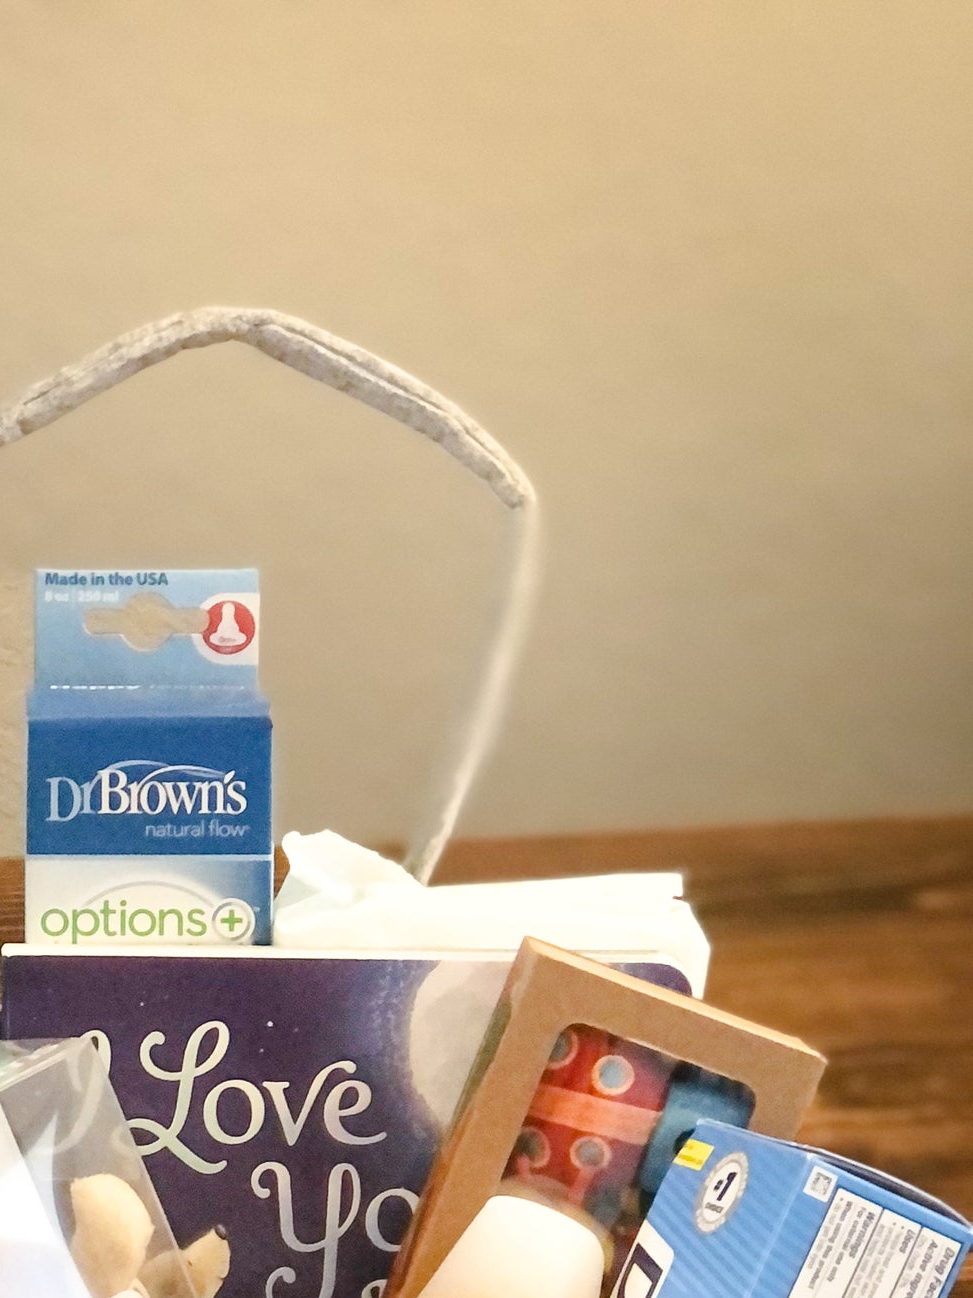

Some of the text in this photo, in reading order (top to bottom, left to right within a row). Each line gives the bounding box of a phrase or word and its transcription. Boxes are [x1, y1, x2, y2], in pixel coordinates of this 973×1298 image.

[45, 572, 168, 586] Made in the USA
[145, 818, 246, 838] natural flow
[115, 1020, 388, 1175] Love
[847, 1211, 876, 1258] Warnings
[899, 1229, 915, 1253] Uses
[918, 1240, 938, 1271] Active
[934, 1246, 955, 1275] Drug
